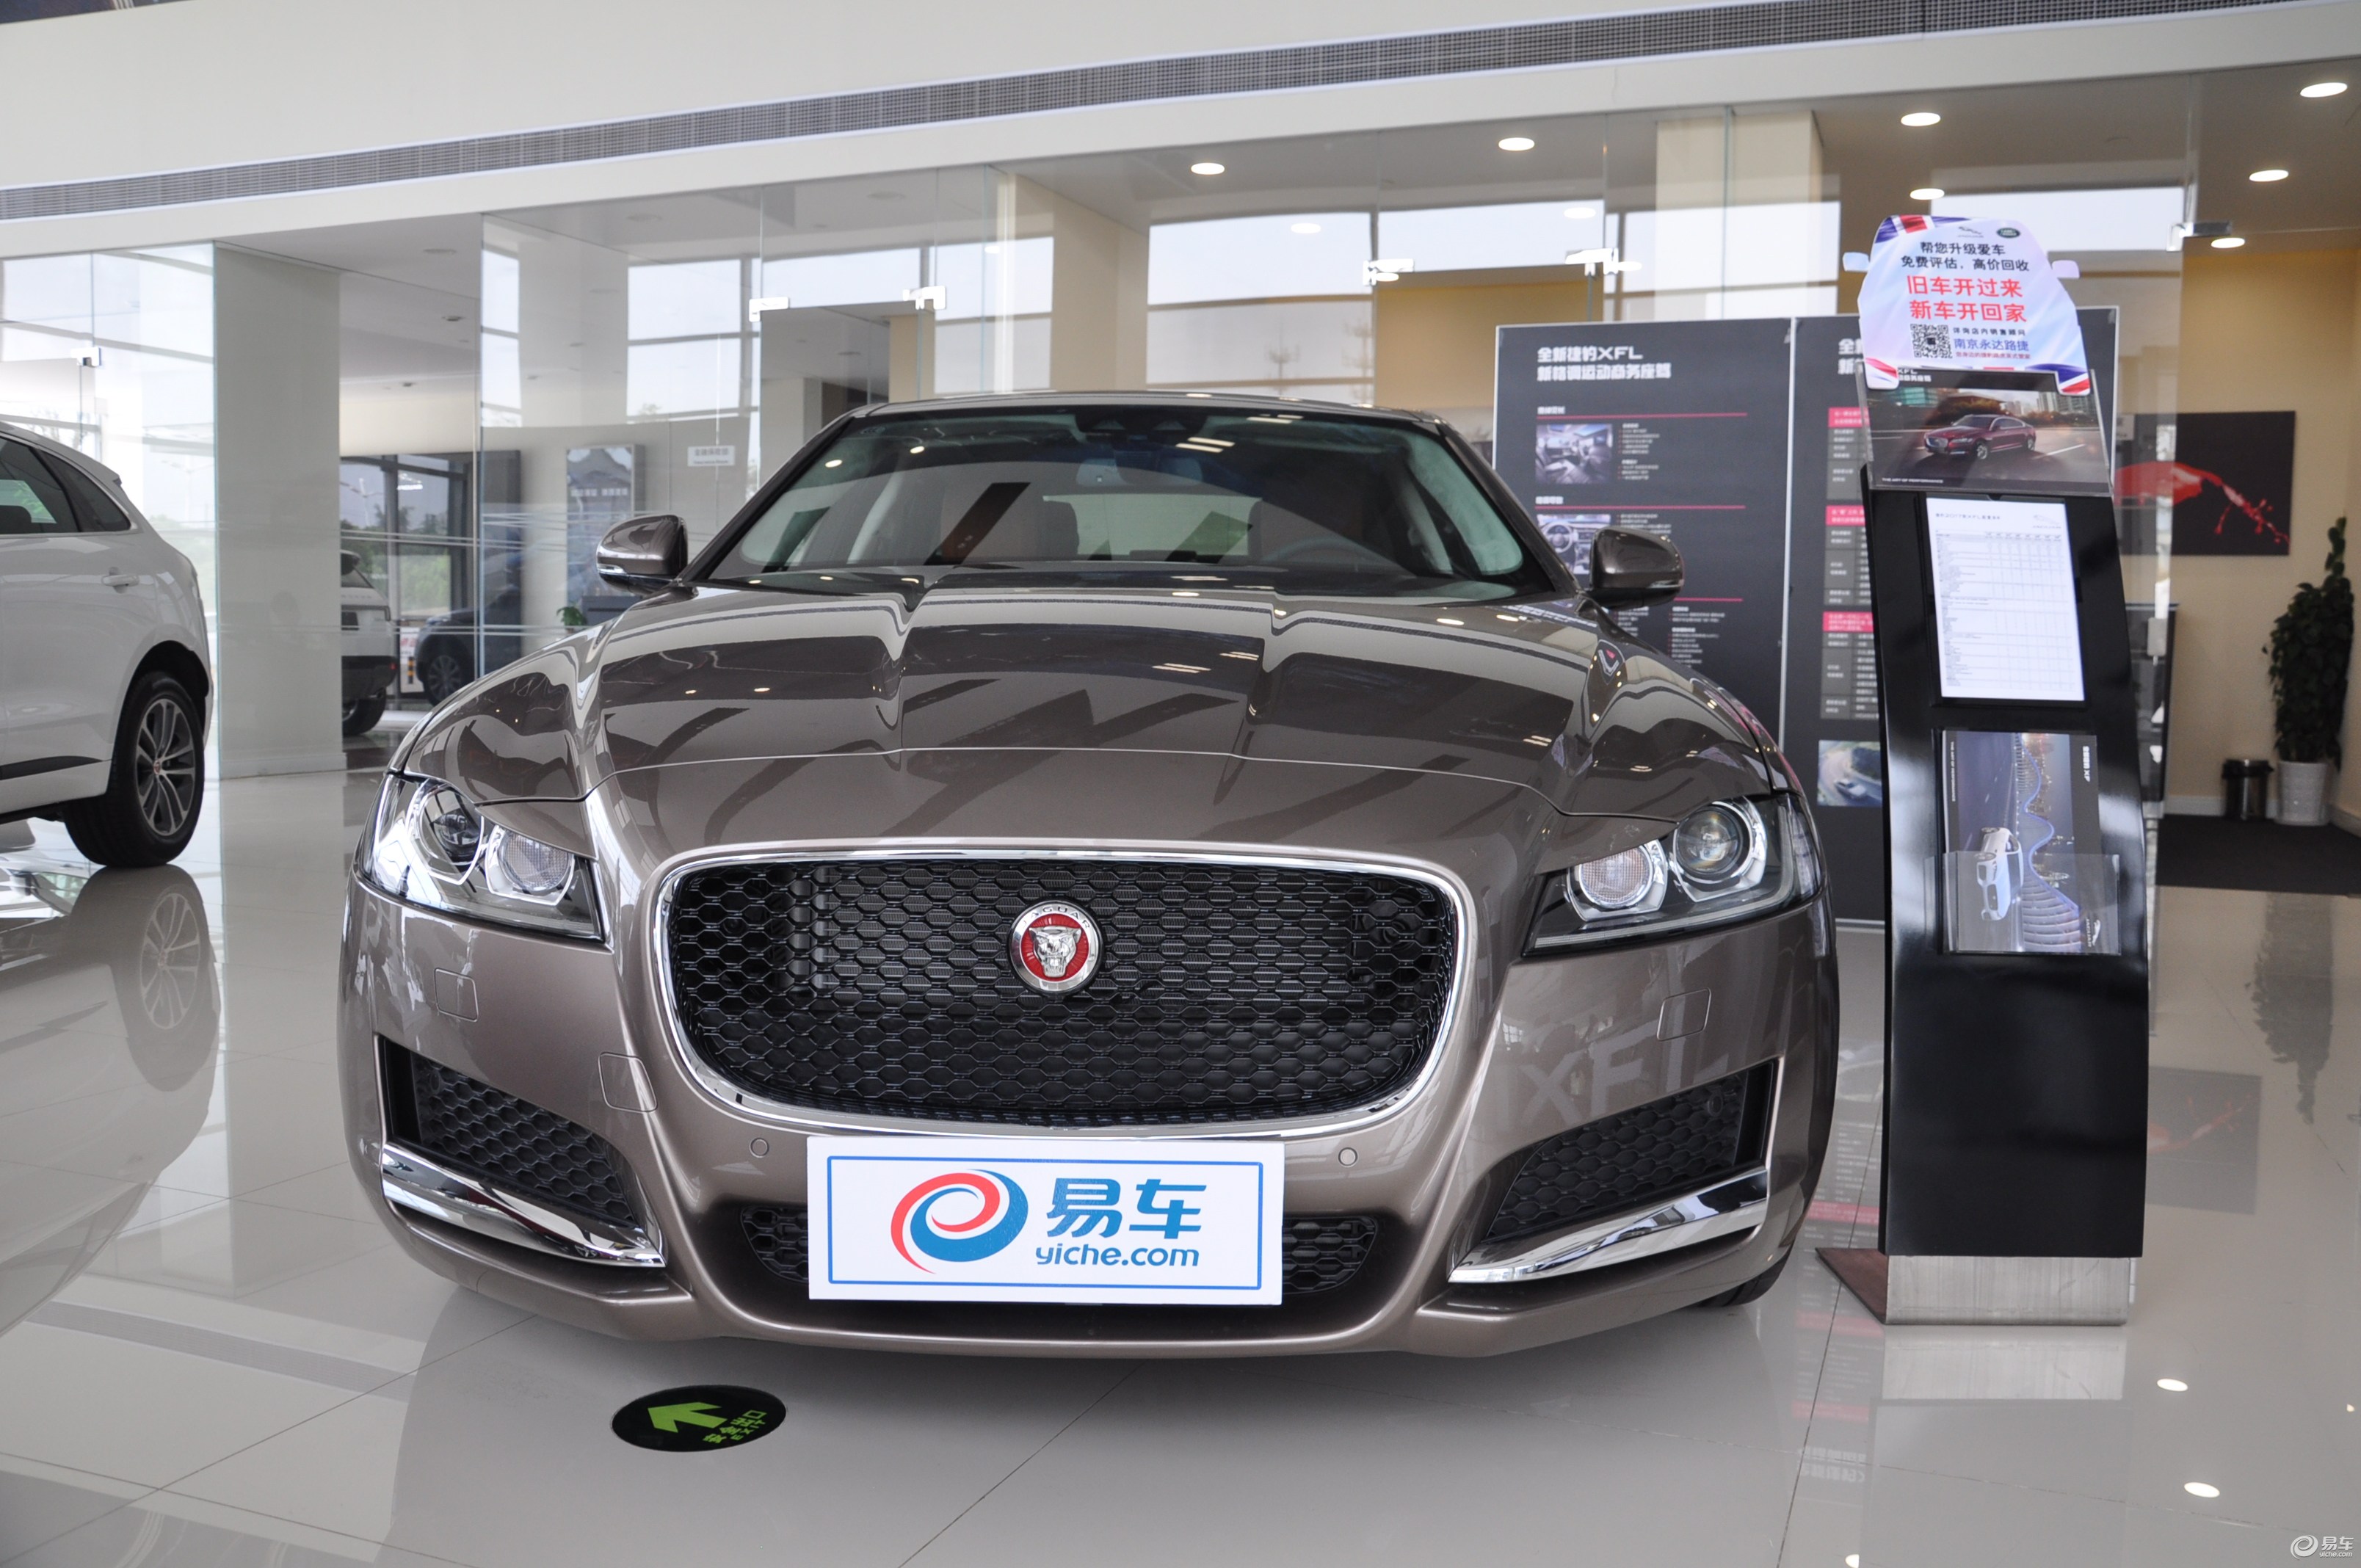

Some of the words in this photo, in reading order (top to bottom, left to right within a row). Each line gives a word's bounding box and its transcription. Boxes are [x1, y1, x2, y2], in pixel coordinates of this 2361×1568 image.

[1920, 242, 2006, 255] 帮您升级爱车
[1907, 275, 2023, 298] 旧车开过来
[1910, 300, 2027, 323] 新车开回家
[1954, 338, 2029, 351] 南京永达路捷
[1046, 1178, 1207, 1239] 易车
[1035, 1242, 1200, 1267] yiche.com
[730, 1420, 766, 1441] EXIT
